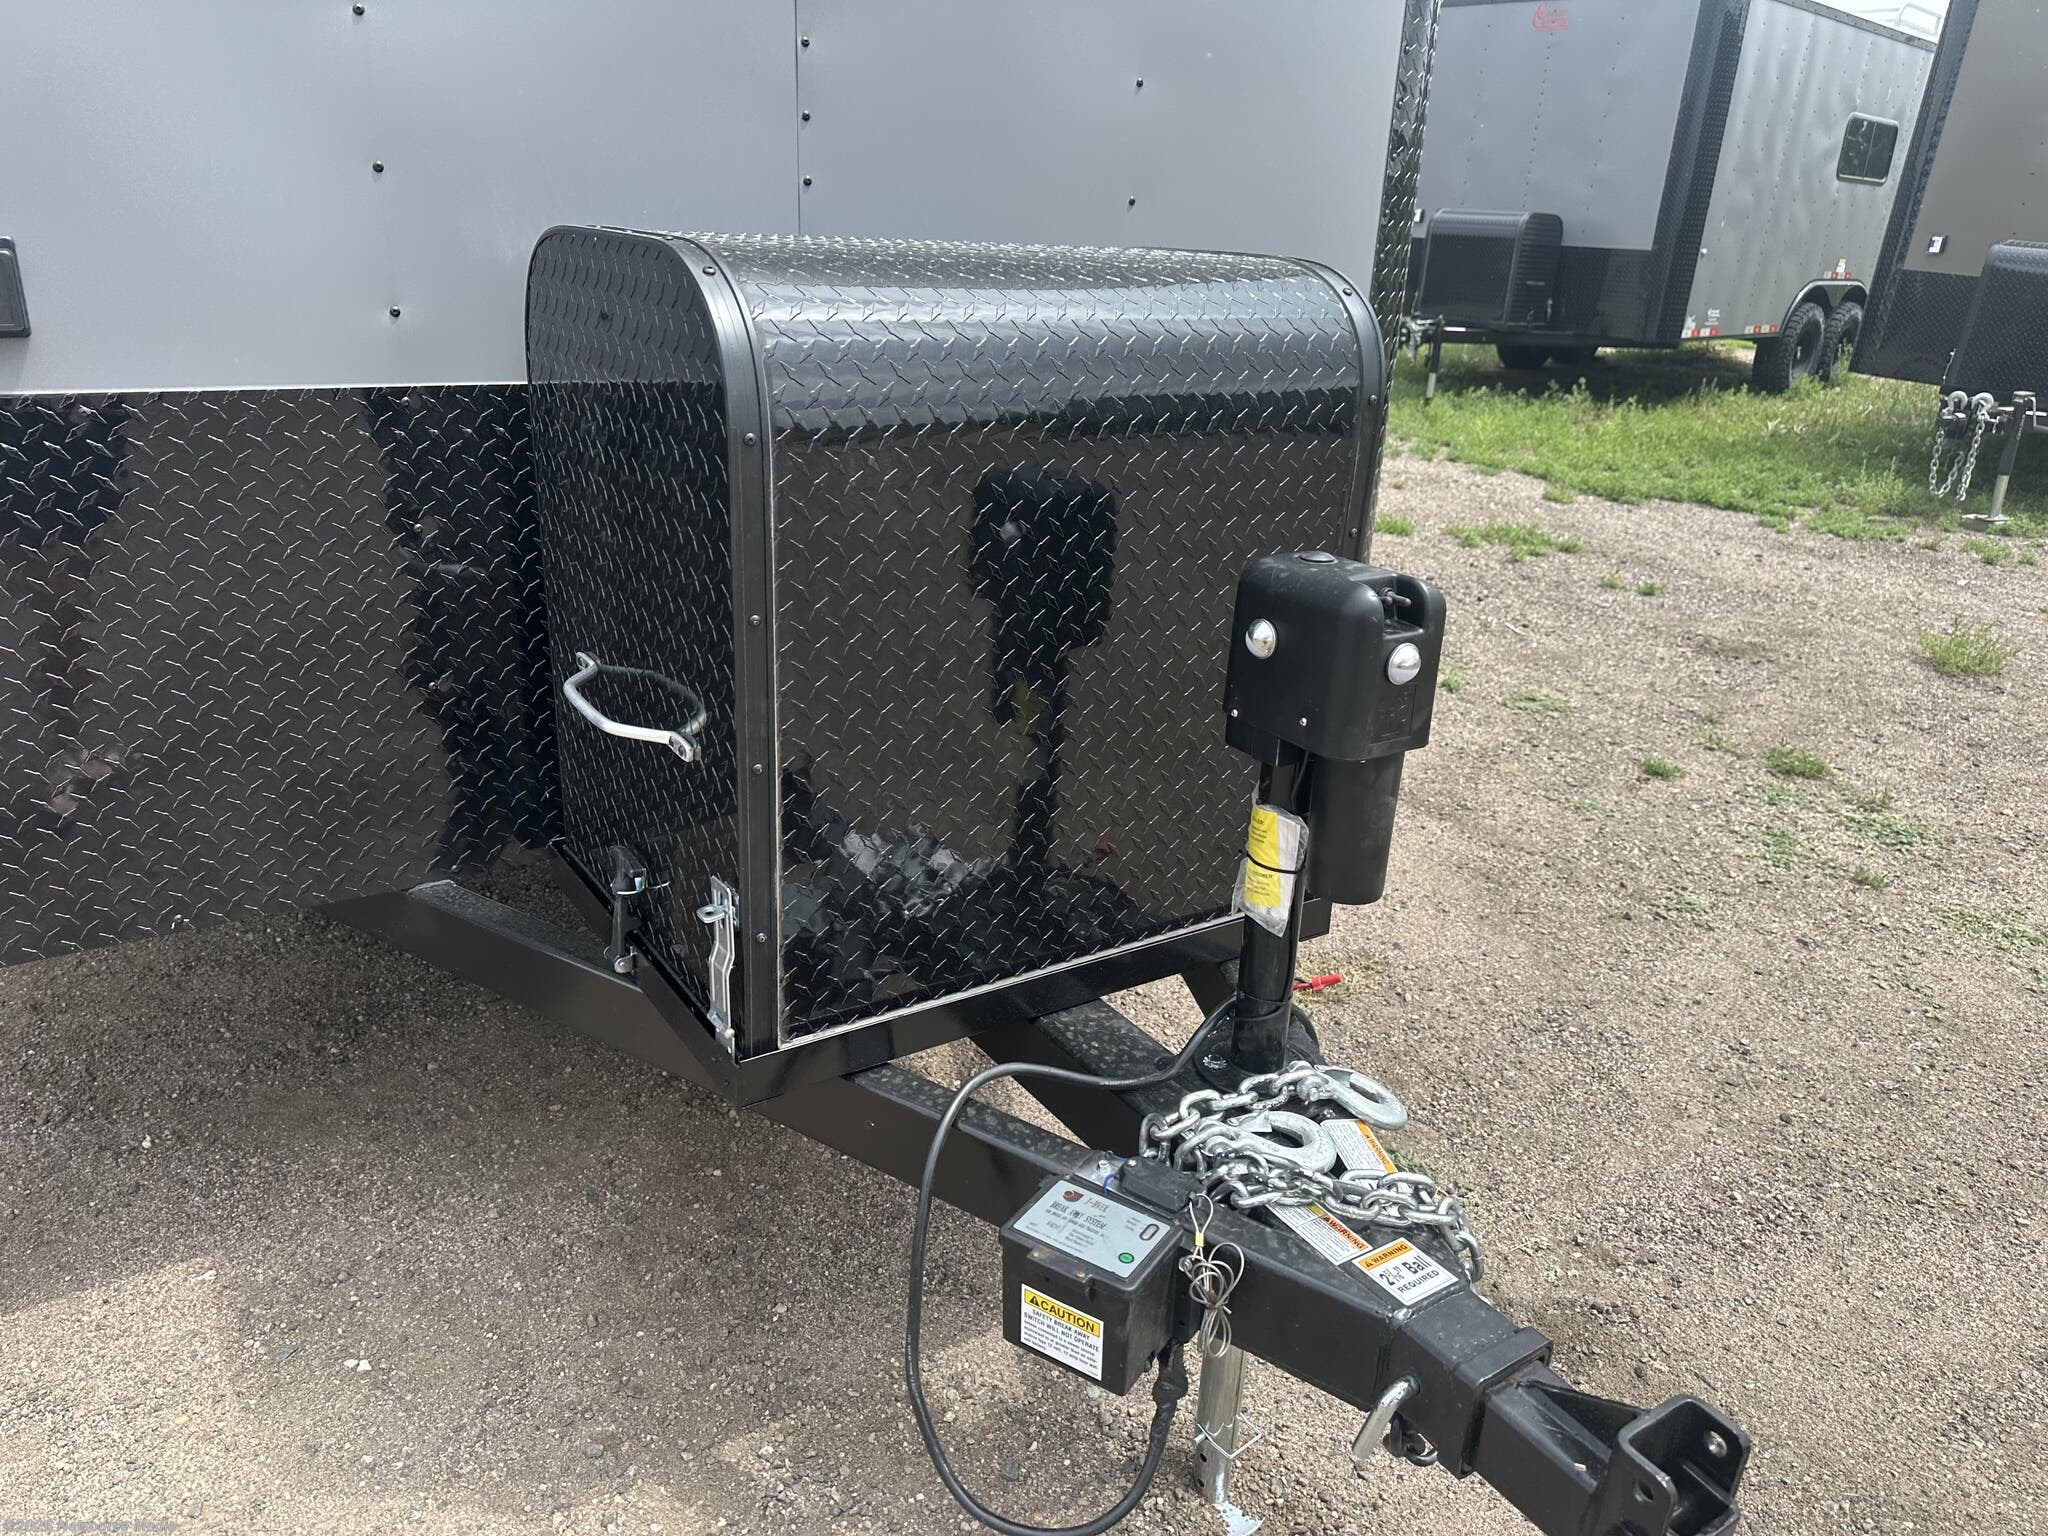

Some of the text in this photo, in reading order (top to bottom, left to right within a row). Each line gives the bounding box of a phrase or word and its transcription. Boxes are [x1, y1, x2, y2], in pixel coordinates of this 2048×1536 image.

[1329, 1219, 1365, 1249] WARNING
[1373, 1244, 1408, 1263] WARNING
[1401, 1255, 1432, 1274] Ball
[1397, 1270, 1440, 1293] REQUIRED
[1032, 1308, 1090, 1341] SAFETY BREAK AWAY
[1040, 1300, 1094, 1332] CAUTION
[1024, 1311, 1098, 1352] SWITCH WILL NOT OPERATE
